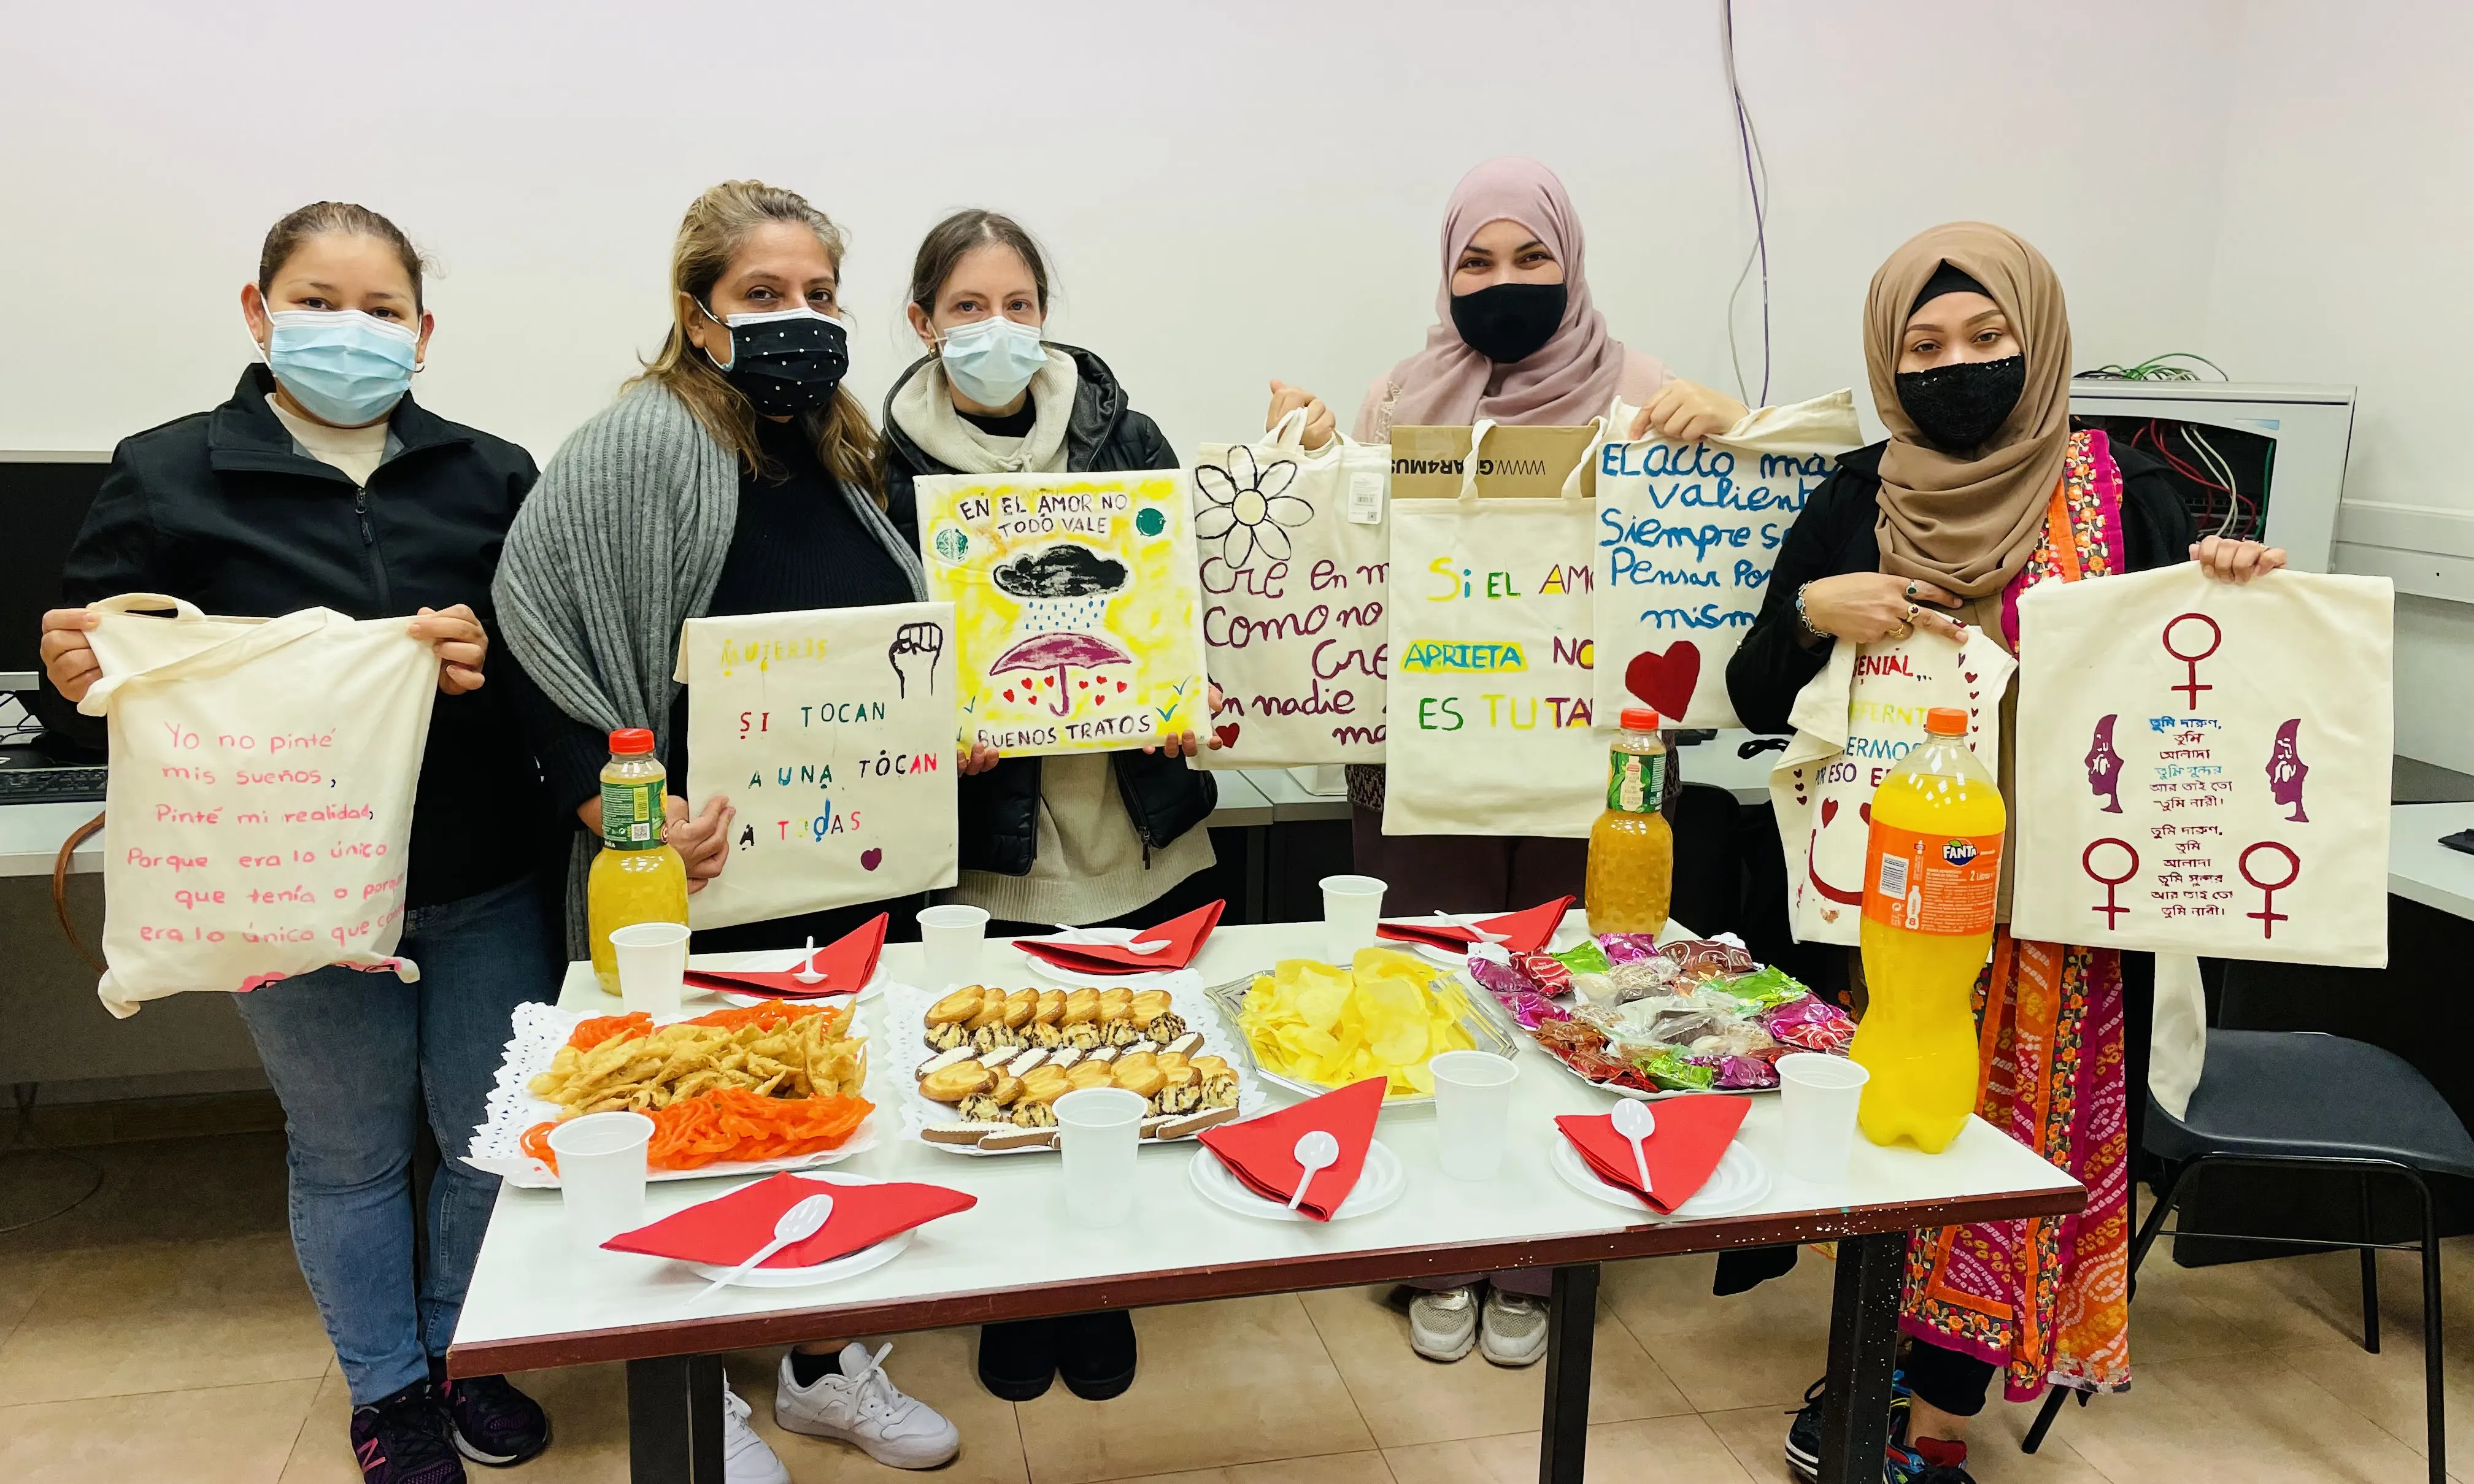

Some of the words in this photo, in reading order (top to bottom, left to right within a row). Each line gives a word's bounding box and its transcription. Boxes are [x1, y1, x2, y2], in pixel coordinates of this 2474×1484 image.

[1391, 459, 1546, 475] WWW.GAR4MU
[960, 498, 989, 521] EN
[1001, 496, 1027, 516] EL
[1038, 493, 1093, 514] AMOR
[1101, 494, 1128, 510] NO
[1649, 477, 1814, 512] valient
[998, 517, 1054, 537] TODO
[1062, 517, 1107, 534] VALE
[1199, 557, 1289, 599] Cre
[1310, 559, 1348, 591] en
[1355, 562, 1390, 585] m
[1486, 571, 1522, 599] EL
[1538, 564, 1594, 595] AM
[1336, 601, 1384, 629] no
[1640, 604, 1755, 629] mism
[1312, 639, 1388, 680] Cre
[1404, 642, 1522, 669] APRIETA
[1251, 679, 1356, 717] nadie
[739, 711, 771, 739] SI
[801, 701, 885, 728] TOCAN
[1418, 696, 1465, 731] ES
[1544, 697, 1593, 729] TA
[2149, 716, 2176, 734] তুমি
[163, 721, 200, 750] Yo
[218, 733, 255, 750] no
[270, 727, 337, 754] pinté
[978, 727, 1058, 749] BUENOS
[1065, 714, 1150, 740] TRATOS
[2173, 730, 2205, 746] তুমি
[1843, 736, 1922, 761] ERMO
[162, 766, 216, 785] mis
[747, 769, 763, 790] A
[777, 764, 833, 790] UNA
[858, 752, 938, 779] TOCAN
[1828, 762, 1857, 784] ESO
[2154, 764, 2184, 780] তুমি
[2211, 781, 2232, 791] তো
[155, 803, 224, 825] Pinté
[237, 809, 269, 825] mi
[2153, 796, 2185, 812] তুমি
[739, 823, 756, 848] A
[2150, 824, 2176, 839] তুমি
[1943, 845, 1978, 859] FANTA
[2175, 840, 2201, 855] তুমি
[126, 847, 209, 874] Porque
[238, 853, 282, 868] era
[293, 850, 315, 864] lo
[1970, 870, 1976, 882] 2
[2158, 871, 2183, 887] তুমি
[174, 888, 225, 910] que
[245, 885, 316, 905] tenía
[333, 886, 349, 899] o
[2212, 891, 2233, 899] তো
[2161, 904, 2186, 919] তুমি
[139, 925, 184, 942] era
[195, 925, 225, 942] lo
[331, 920, 370, 948] que
